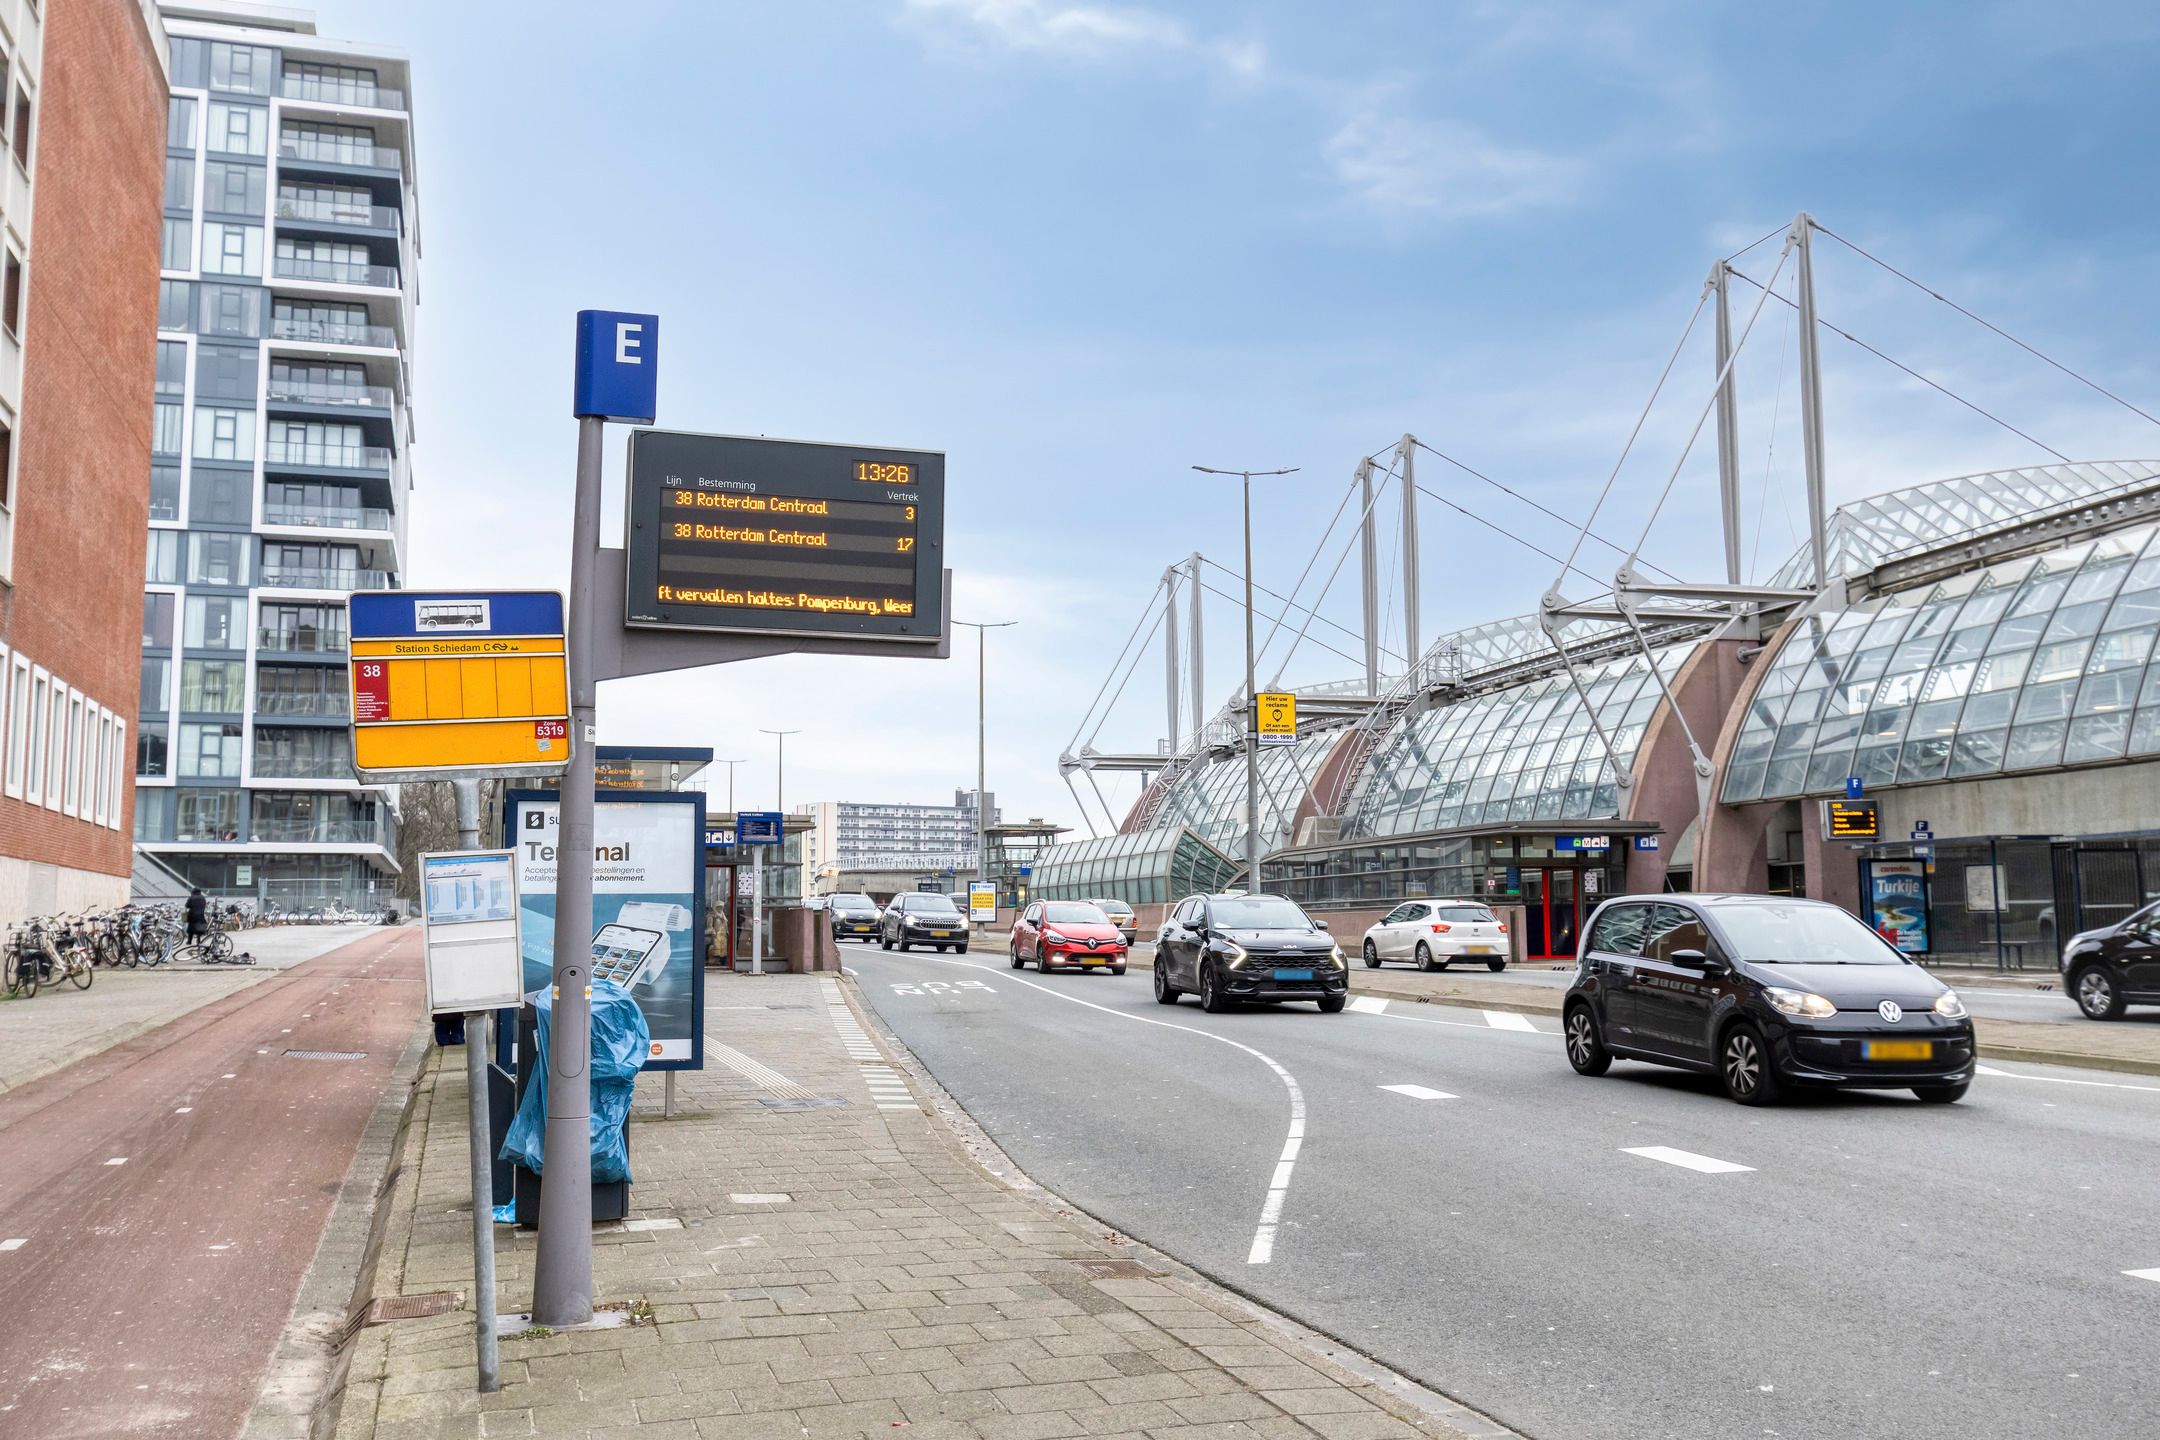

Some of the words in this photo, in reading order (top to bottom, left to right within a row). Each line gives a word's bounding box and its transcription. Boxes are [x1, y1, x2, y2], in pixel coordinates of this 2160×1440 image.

[616, 322, 642, 364] E
[858, 464, 908, 482] 13:26
[666, 475, 682, 486] Lijn
[698, 477, 756, 492] Bestemming
[887, 491, 919, 502] Vertrek
[675, 492, 692, 505] 38
[697, 493, 765, 510] Rotterdam
[770, 498, 828, 514] Centraal
[905, 507, 914, 520] 3
[674, 524, 691, 538] 38
[696, 525, 764, 542] Rotterdam
[769, 530, 827, 546] Centraal
[897, 538, 914, 550] 17
[676, 589, 744, 604] vervallen
[747, 591, 795, 606] haltes:
[799, 594, 881, 615] Pompenburg,
[395, 644, 430, 653] Station
[433, 644, 480, 652] Schiedam
[363, 665, 380, 677] 38
[537, 726, 564, 735] 5319
[1852, 779, 1859, 788] F
[1877, 879, 1920, 896] Turkije
